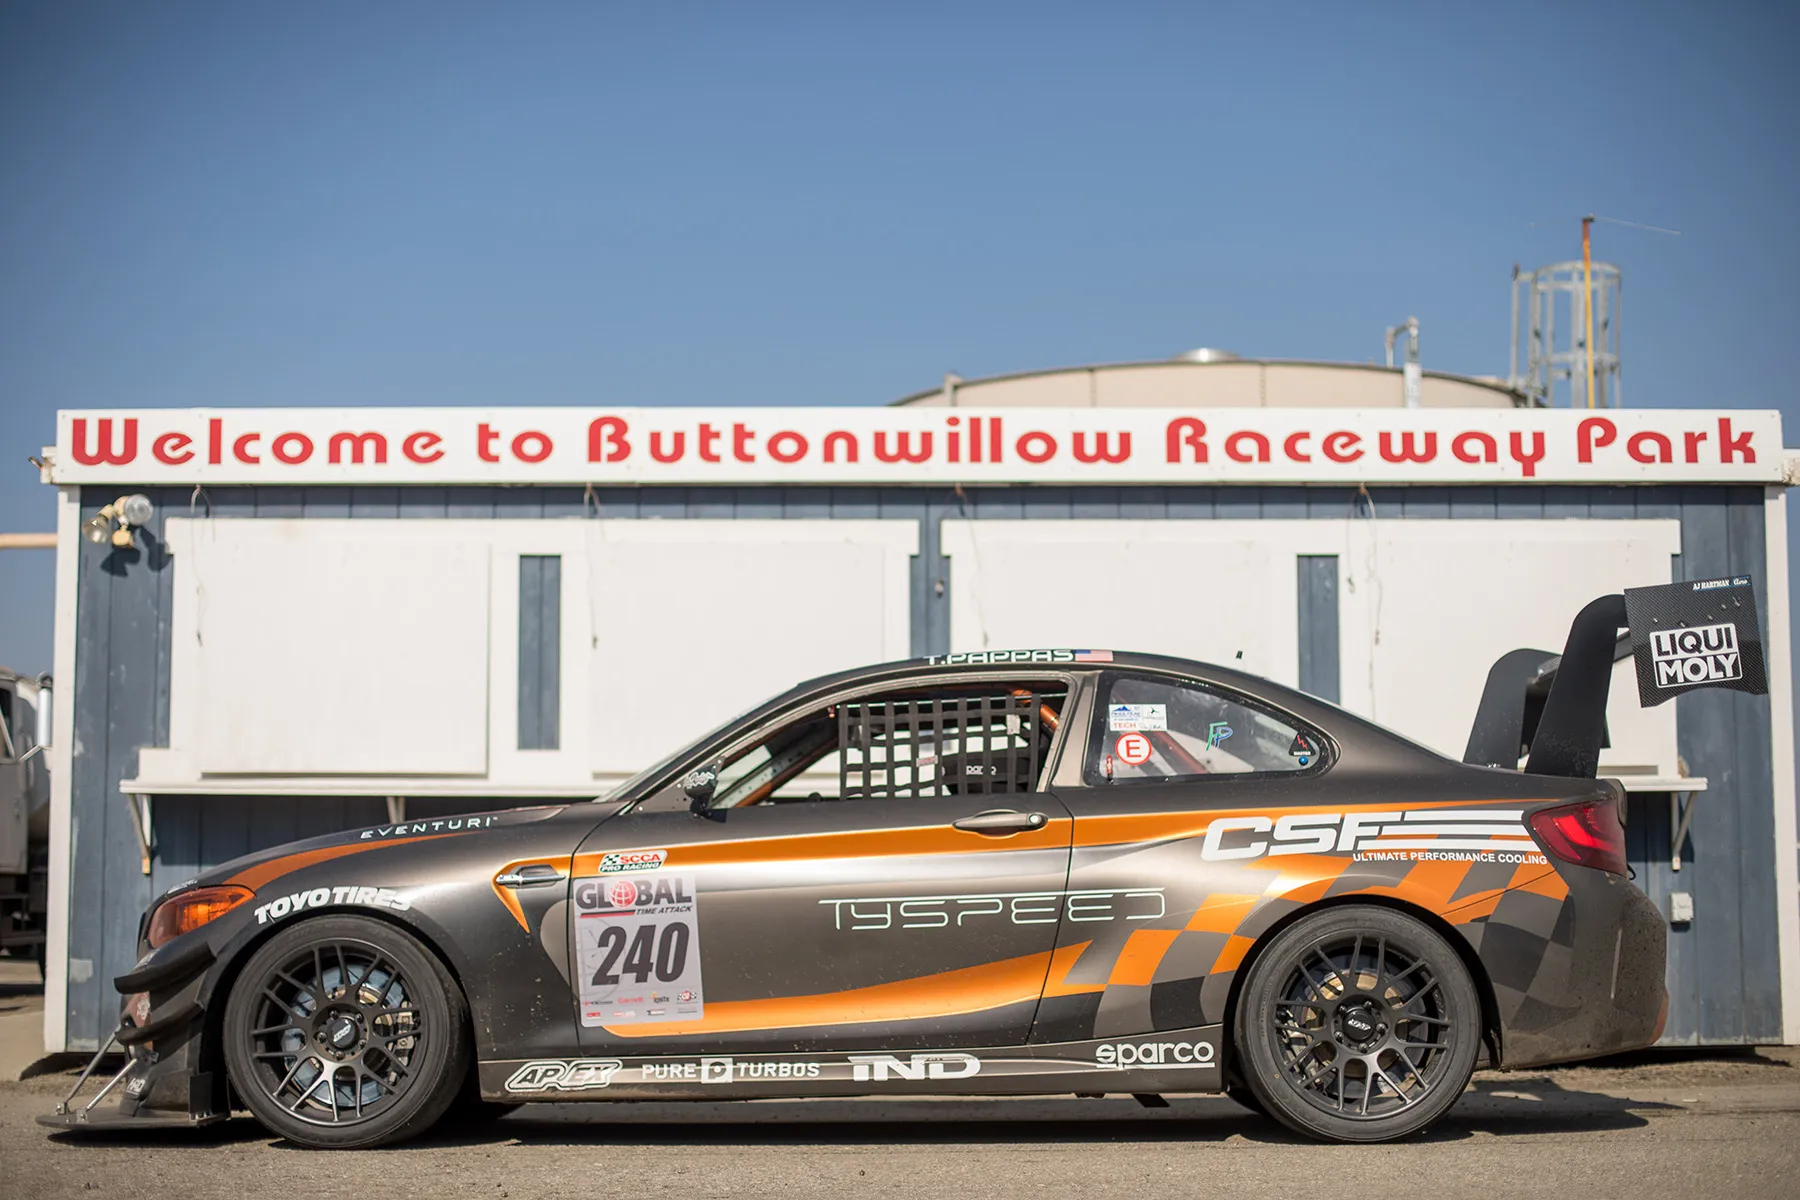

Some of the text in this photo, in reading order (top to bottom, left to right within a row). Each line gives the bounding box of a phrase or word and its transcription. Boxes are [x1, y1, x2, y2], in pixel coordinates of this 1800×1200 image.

[71, 415, 1757, 478] Welcome to Buttonwillow Raceway Park
[923, 649, 1074, 665] T.PAPPAS
[1655, 627, 1733, 658] LIQUI
[1659, 654, 1737, 685] MOLY
[1126, 740, 1141, 758] E
[361, 817, 491, 839] EVENTURI
[1200, 811, 1402, 861] CSF
[602, 861, 660, 872] PRO RACING
[620, 854, 660, 864] SCCA
[1353, 852, 1547, 865] ULTIMATE PERFORMANCE COOLING
[254, 886, 412, 925] TOYO TIRES
[576, 877, 692, 909] GLOBAL
[636, 905, 692, 915] TIME ATTACK
[591, 922, 690, 986] 240
[1096, 1041, 1214, 1070] sparco
[508, 1061, 621, 1090] APEX
[642, 1063, 697, 1080] PURE
[737, 1062, 820, 1078] TURBOS
